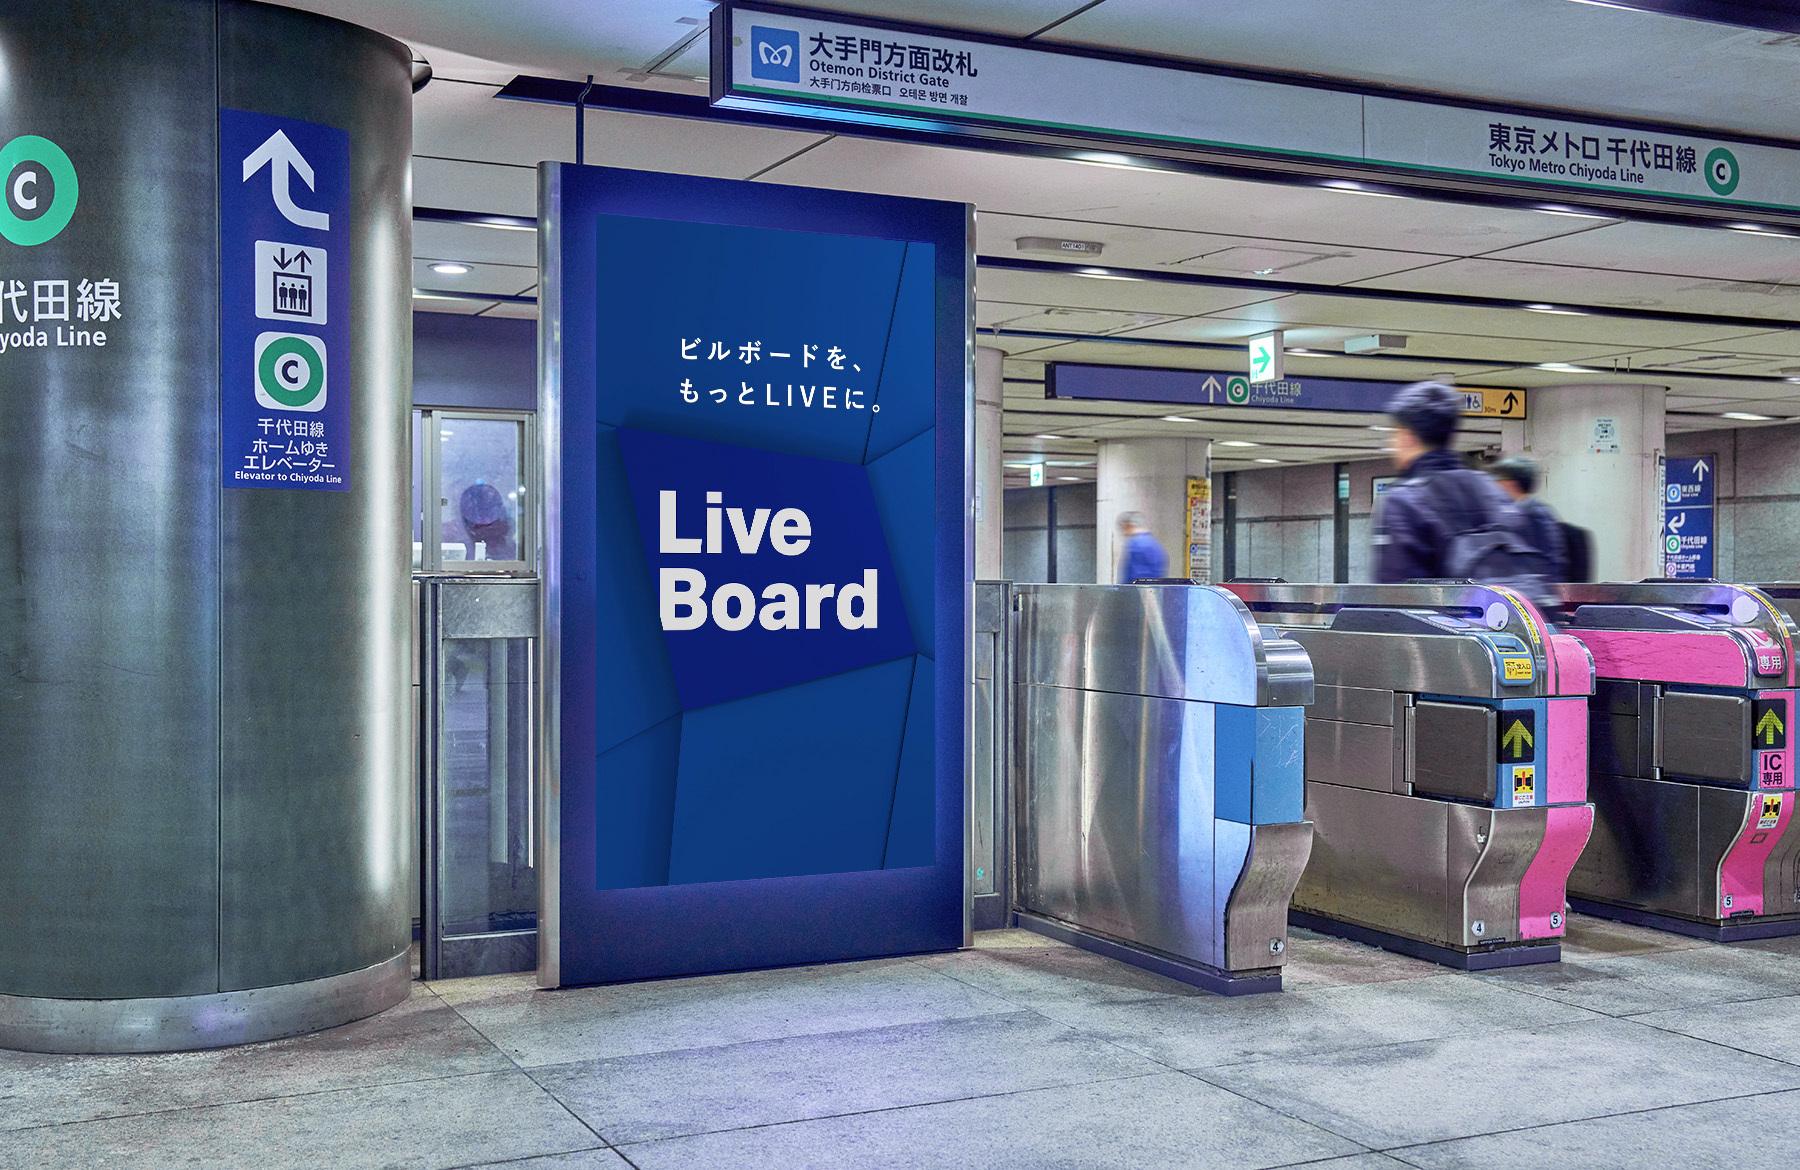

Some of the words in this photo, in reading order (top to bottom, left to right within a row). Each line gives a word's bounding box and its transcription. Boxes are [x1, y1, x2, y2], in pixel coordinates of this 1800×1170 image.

[809, 32, 978, 77] 大手門方面改札
[809, 59, 864, 78] Otemon
[868, 66, 915, 84] District
[919, 72, 950, 88] Gate
[809, 76, 892, 97] 大手门方向检票口
[899, 87, 926, 101] 오테몬
[1489, 153, 1525, 173] Tokyo
[1529, 159, 1566, 175] Metro
[1569, 163, 1617, 182] Chiyoda
[1620, 169, 1644, 184] Line
[1715, 163, 1726, 180] C
[13, 171, 37, 210] C
[57, 325, 107, 346] Line
[680, 337, 862, 372] ビルボードを、
[281, 359, 299, 385] C
[679, 378, 881, 414] もっとLIVEに。
[257, 418, 325, 438] 千代田線
[252, 438, 329, 457] ホームゆき
[243, 455, 335, 473] エレベーター
[234, 471, 274, 481] Elevator
[277, 472, 288, 481] to
[289, 472, 324, 484] Chiyoda
[326, 475, 342, 484] Line
[659, 489, 812, 556] Live
[659, 567, 878, 632] Board
[1759, 655, 1782, 670] 専用
[1763, 754, 1782, 770] IC
[1762, 771, 1783, 786] 専用
[1726, 896, 1732, 906] 5
[1476, 923, 1482, 933] 4
[1552, 915, 1558, 925] 5
[1272, 942, 1279, 951] 4
